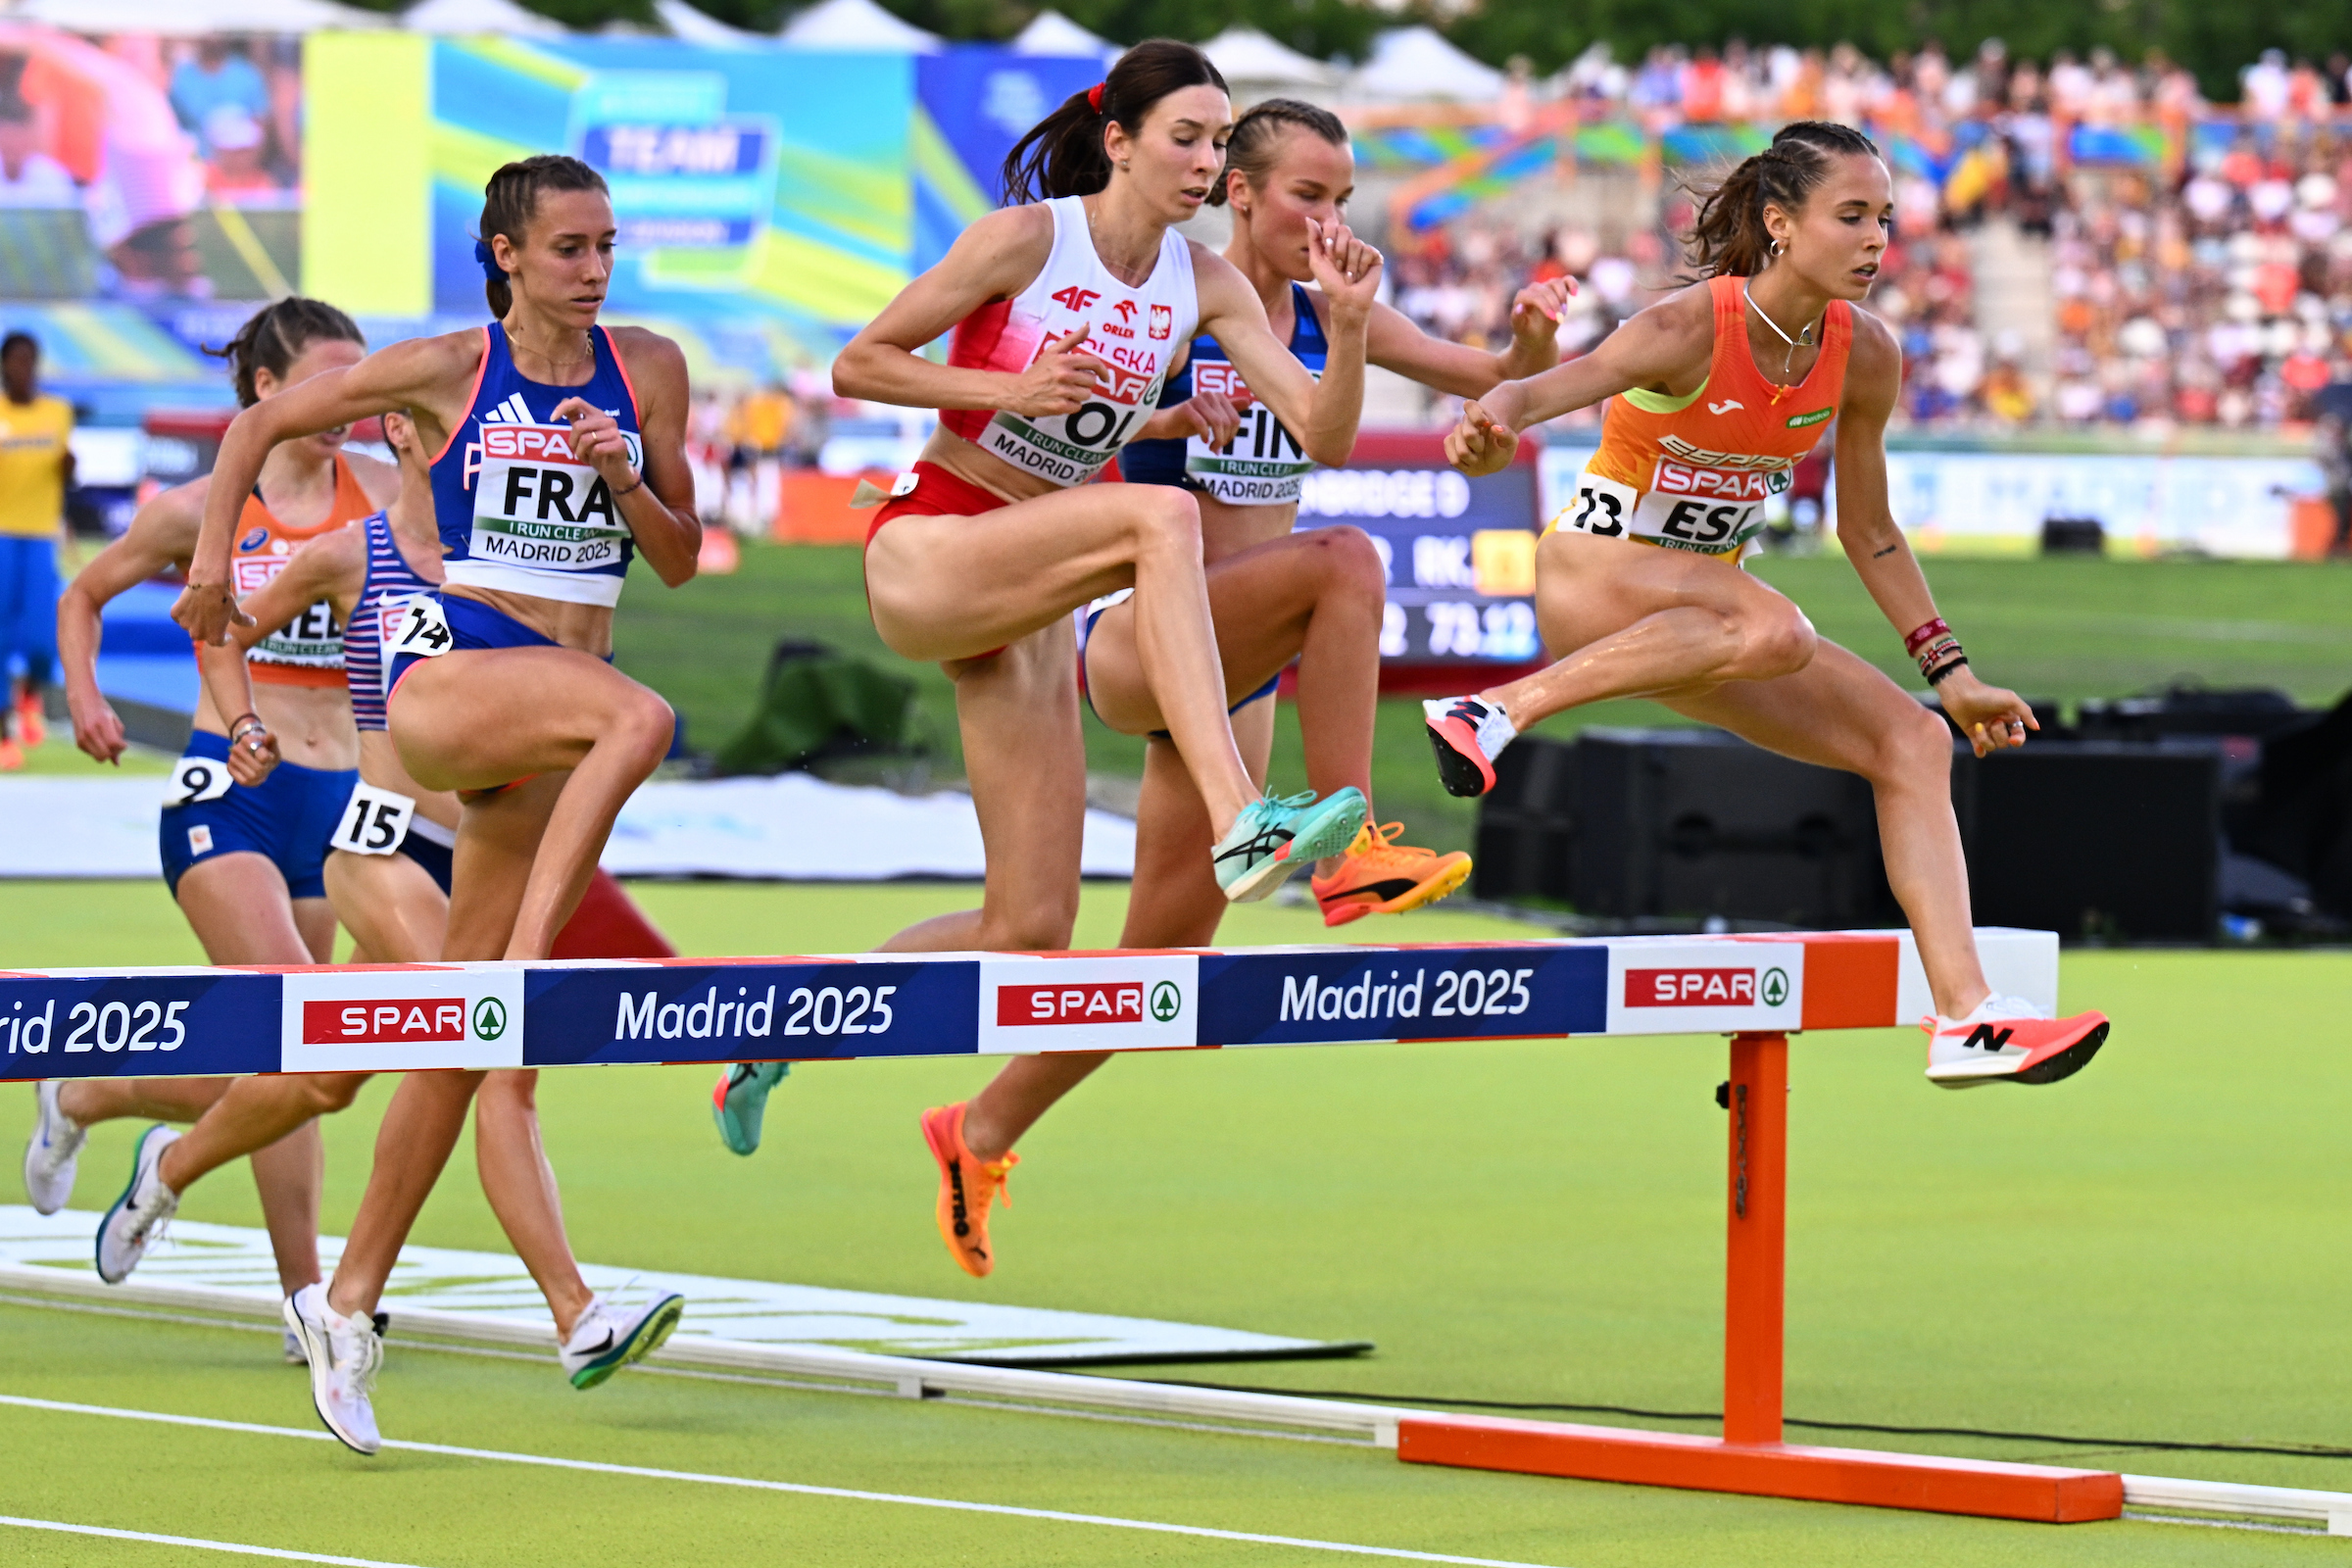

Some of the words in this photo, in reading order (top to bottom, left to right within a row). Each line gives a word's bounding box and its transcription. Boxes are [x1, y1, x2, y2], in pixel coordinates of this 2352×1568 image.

[1052, 286, 1102, 312] 4F
[1102, 322, 1135, 339] ORLEN
[486, 430, 582, 462] SPA
[1025, 428, 1032, 438] I
[1032, 432, 1064, 453] RUN
[1223, 409, 1303, 460] FIN
[995, 434, 1075, 480] MADRID
[1227, 462, 1258, 475] RUN
[504, 466, 615, 526] FRA
[1199, 477, 1273, 499] MADRID
[1661, 465, 1764, 497] SPAR
[510, 522, 514, 533] I
[516, 523, 551, 538] RUN
[1662, 501, 1756, 542] ES
[486, 536, 571, 562] MADRID
[575, 541, 611, 563] 2025
[402, 608, 450, 649] 14
[182, 766, 212, 806] 9
[350, 800, 401, 849] 15
[1280, 968, 1425, 1021] Madrid
[1432, 968, 1534, 1017] 2025
[1654, 973, 1754, 1002] SPAR
[614, 985, 776, 1041] Madrid
[784, 986, 897, 1036] 2025
[1030, 989, 1141, 1019] SPAR
[65, 1001, 190, 1053] 2025
[341, 1005, 462, 1036] SPAR
